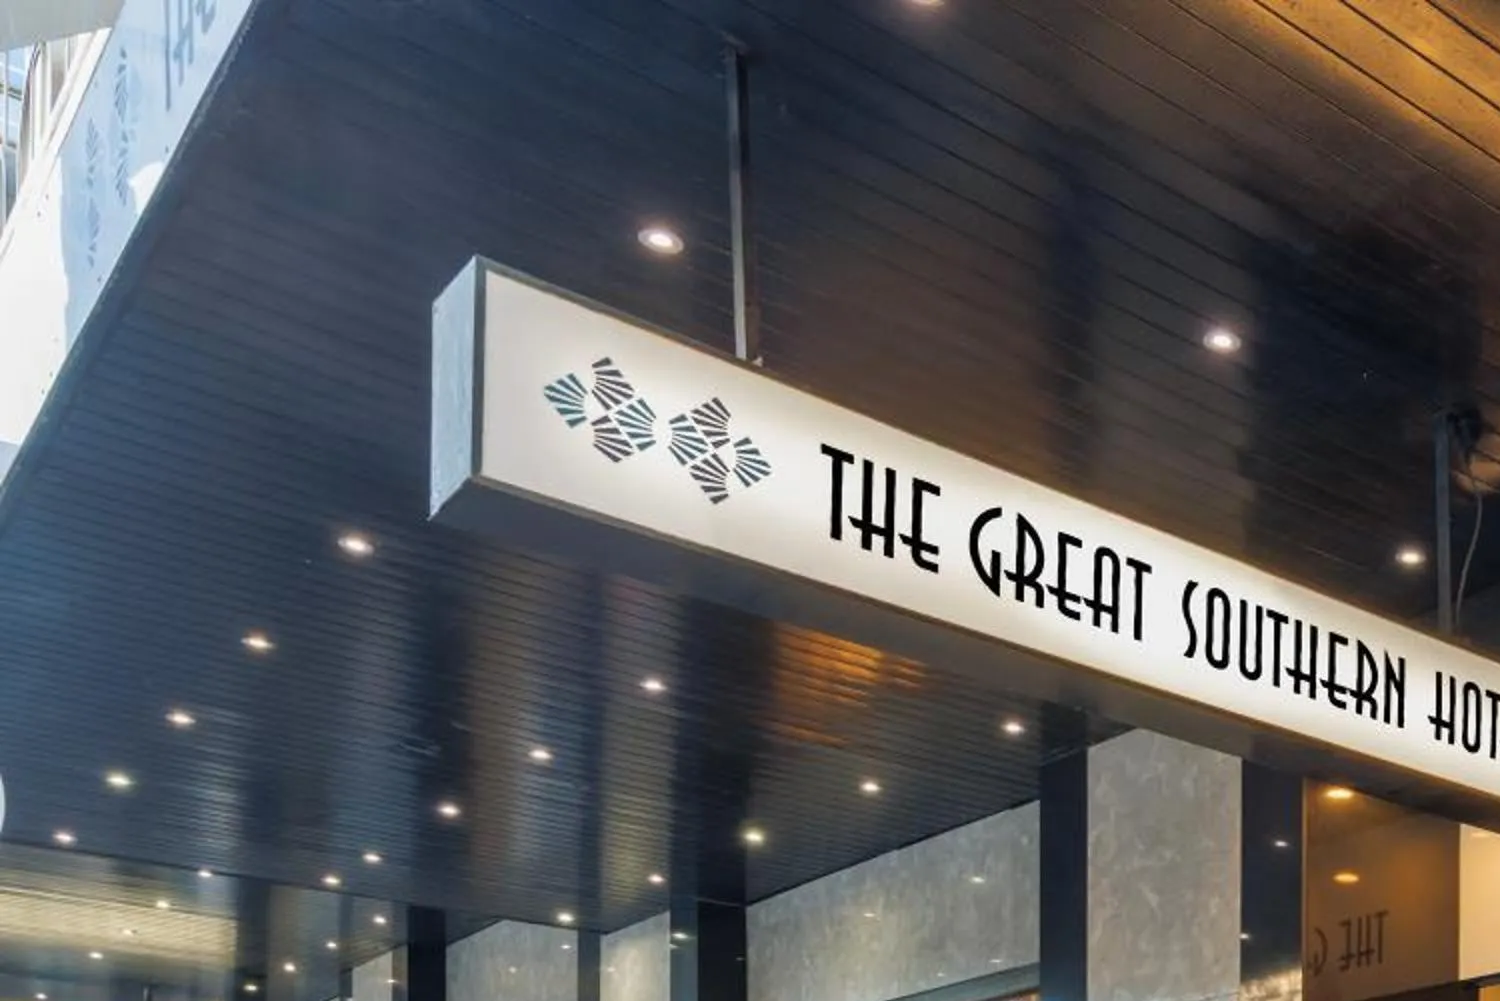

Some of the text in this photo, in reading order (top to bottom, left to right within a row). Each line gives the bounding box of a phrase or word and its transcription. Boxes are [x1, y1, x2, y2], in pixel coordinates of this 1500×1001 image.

[820, 443, 941, 574] THE
[968, 506, 1152, 642] GREAT
[1181, 579, 1406, 729] SOUTHERN
